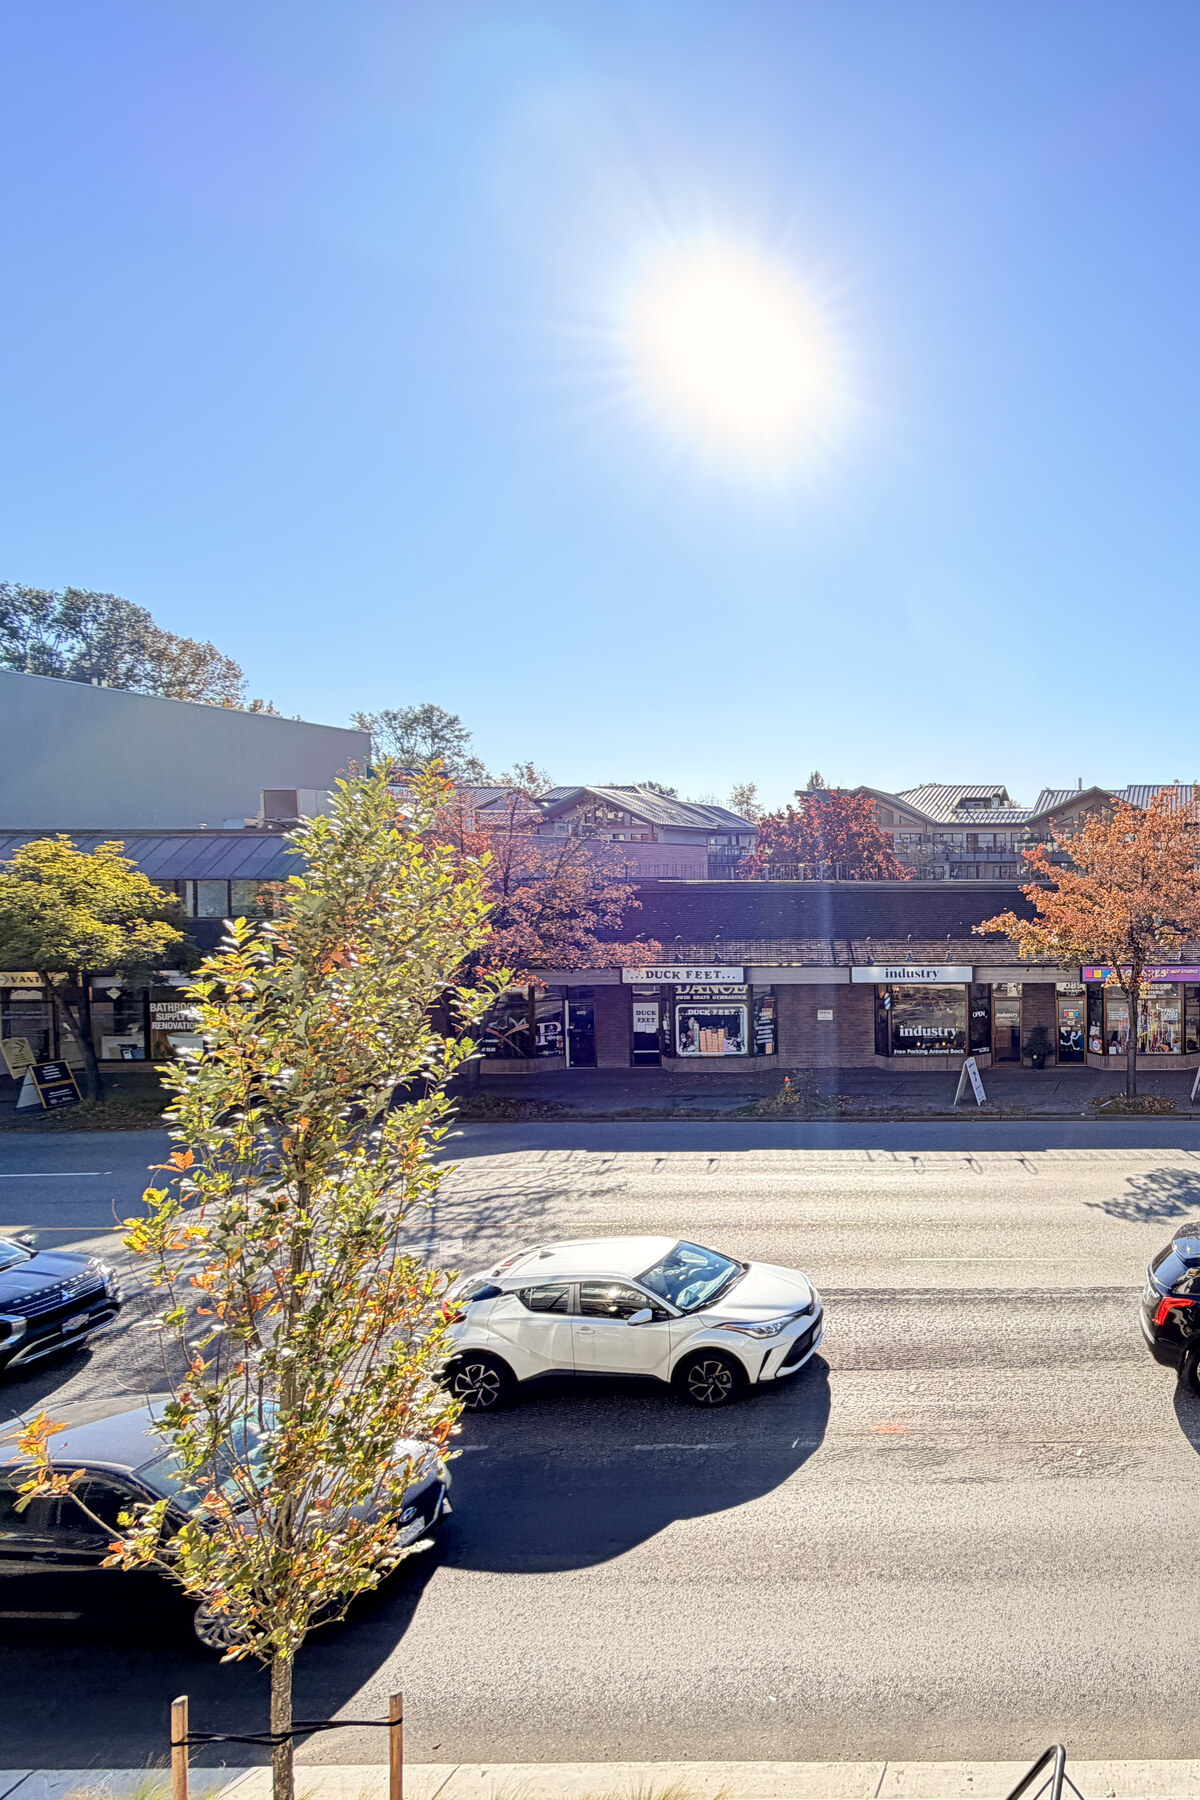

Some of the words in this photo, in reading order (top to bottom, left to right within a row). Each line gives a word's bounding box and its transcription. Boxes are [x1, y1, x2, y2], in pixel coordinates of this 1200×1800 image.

[885, 968, 939, 980] industry
[675, 985, 748, 994] DANCE
[899, 1025, 958, 1039] industry
